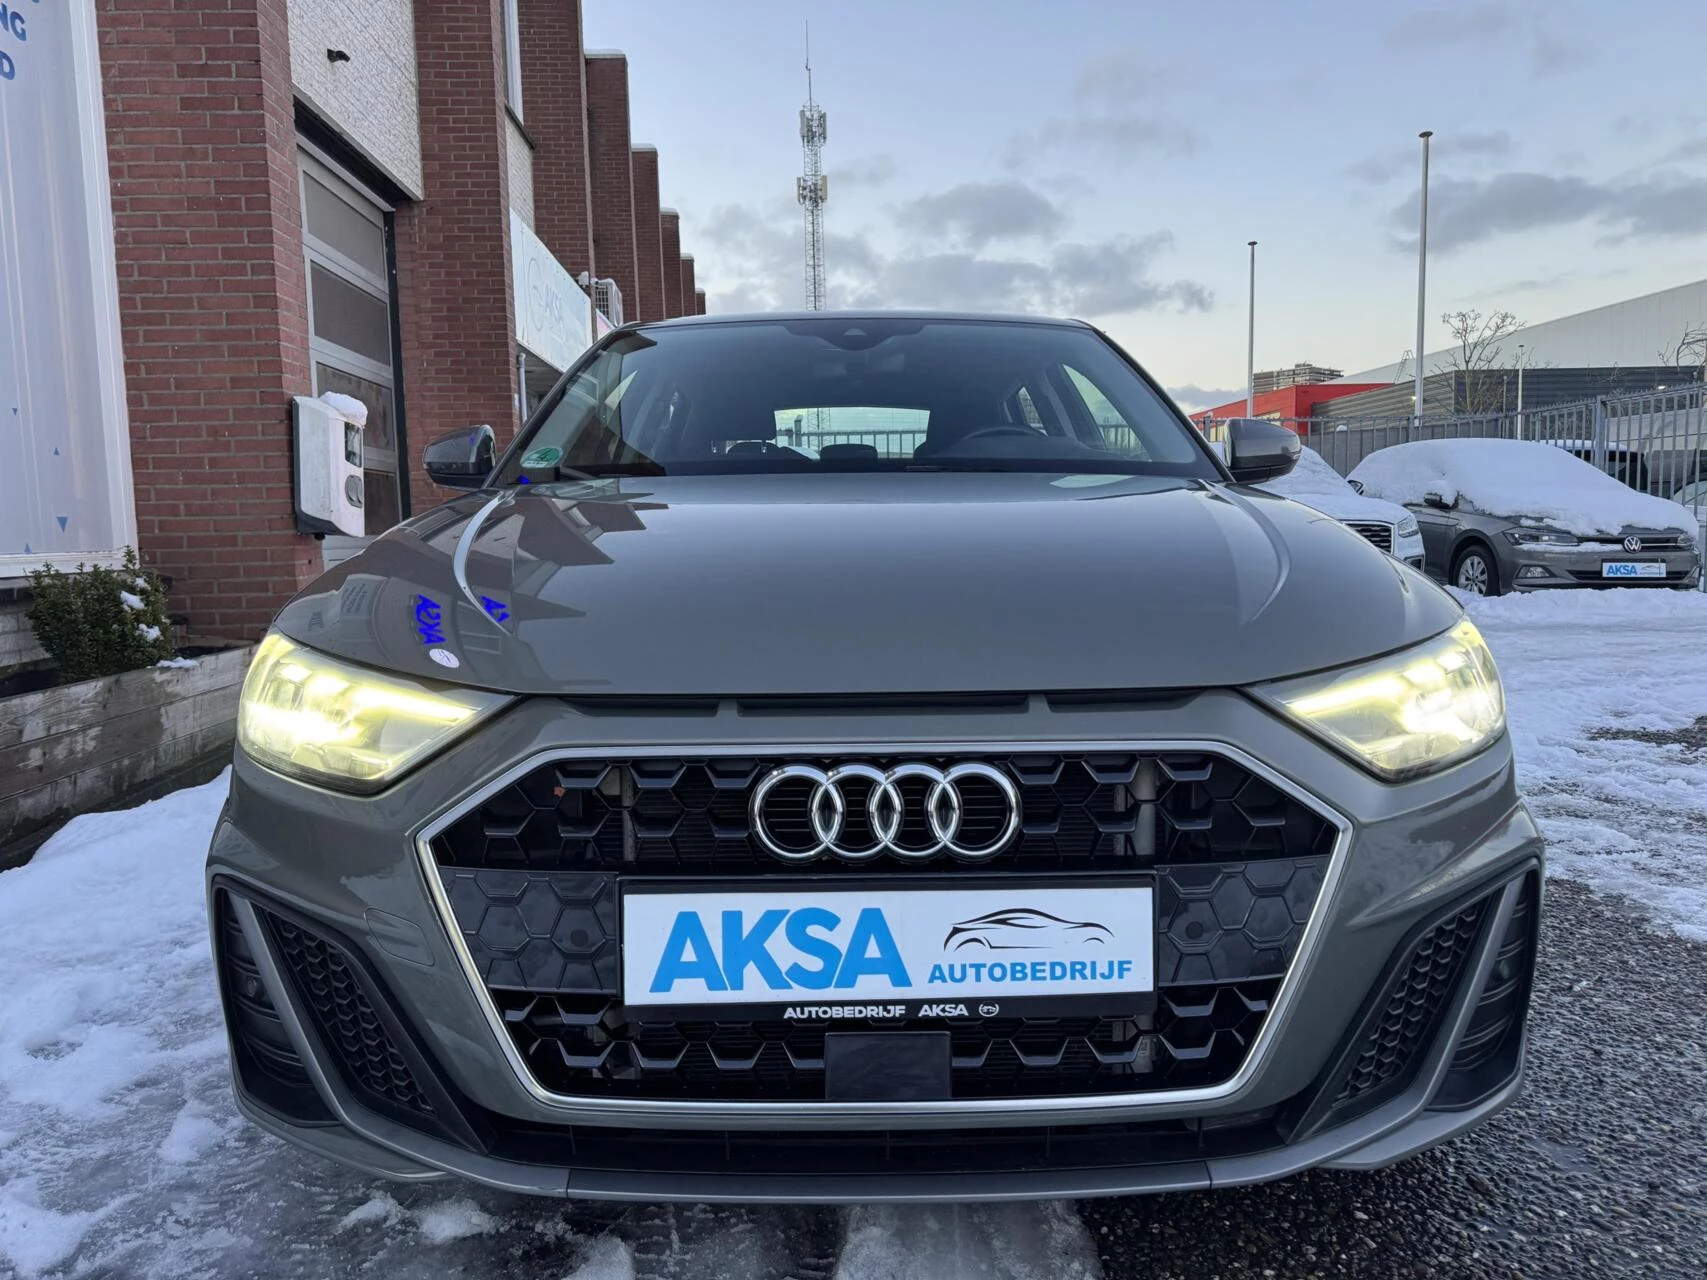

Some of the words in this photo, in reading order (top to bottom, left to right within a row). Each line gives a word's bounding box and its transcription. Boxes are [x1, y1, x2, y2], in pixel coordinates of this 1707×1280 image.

[1606, 565, 1638, 576] AKSA
[649, 907, 912, 993] AKSA
[928, 960, 1133, 984] AUTOBEDRIJF
[784, 1005, 906, 1019] AUTOBEDRIJF
[918, 1004, 969, 1017] AKSA
